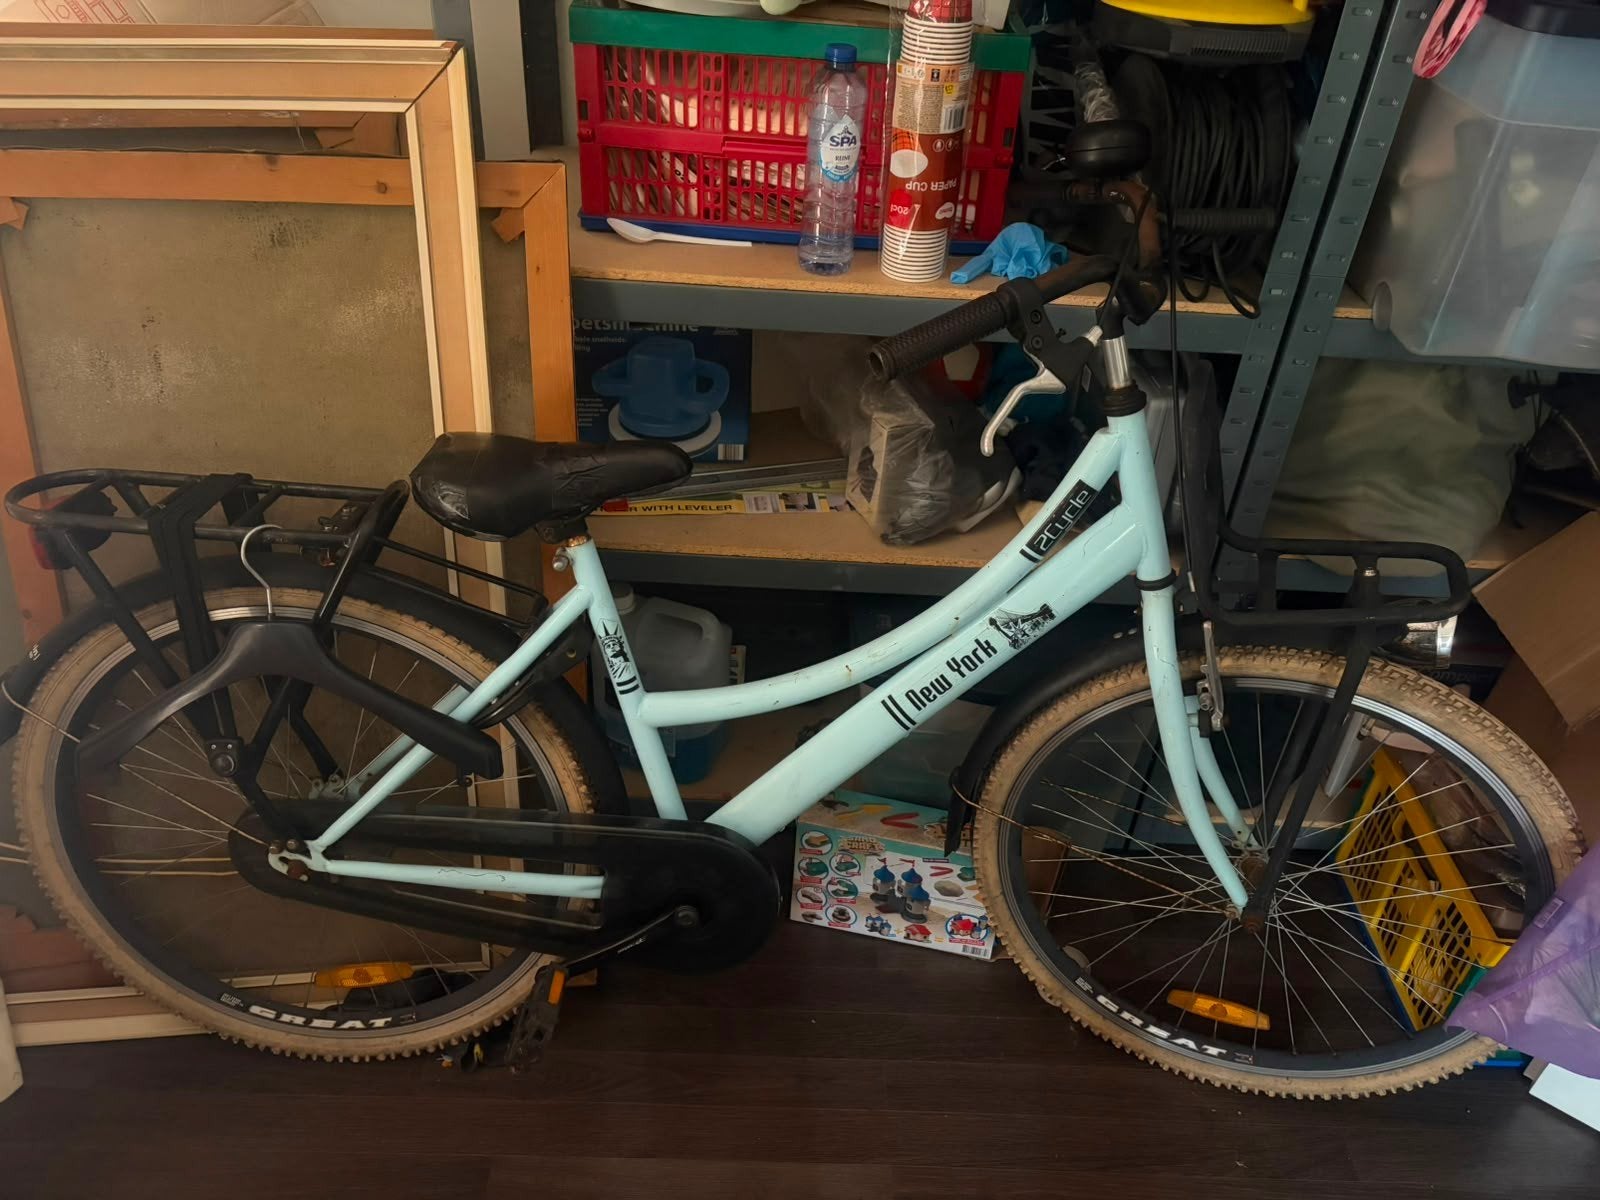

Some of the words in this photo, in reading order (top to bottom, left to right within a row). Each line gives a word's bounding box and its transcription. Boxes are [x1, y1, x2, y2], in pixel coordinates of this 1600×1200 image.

[829, 135, 857, 147] SPA
[905, 181, 928, 192] CUP
[930, 178, 957, 191] PAPER
[890, 204, 910, 215] 20cl
[641, 504, 675, 512] WITH
[677, 504, 734, 512] LEVELER
[1034, 489, 1092, 552] 2Cycle
[904, 674, 953, 712] New
[946, 638, 998, 678] York
[248, 1004, 393, 1030] GREAT
[1095, 994, 1228, 1057] GREAT
